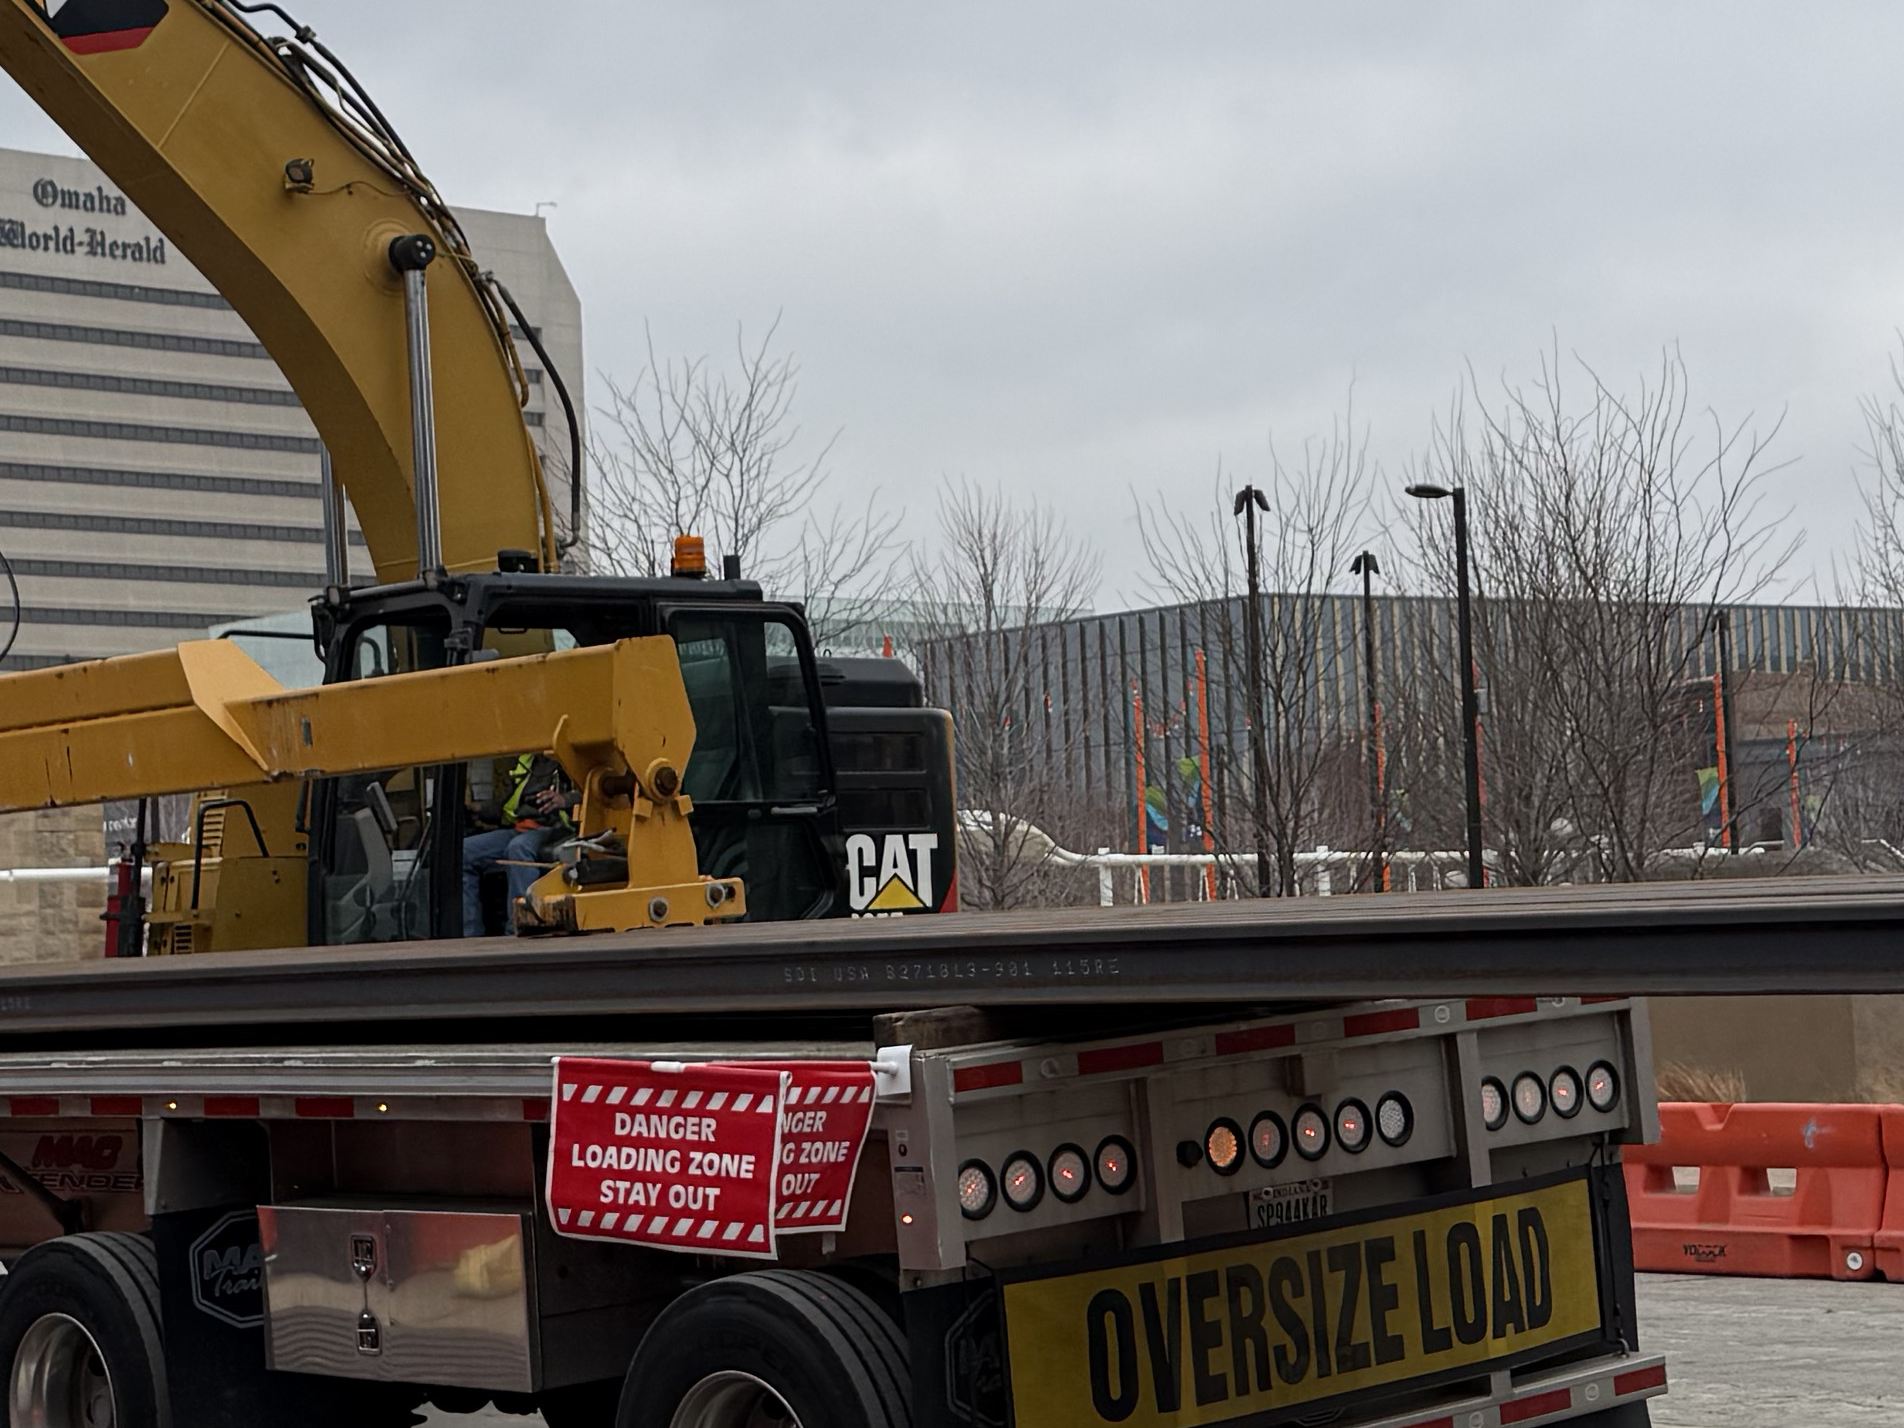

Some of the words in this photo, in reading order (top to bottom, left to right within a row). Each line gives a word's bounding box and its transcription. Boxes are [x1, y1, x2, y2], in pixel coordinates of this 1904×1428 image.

[32, 178, 127, 216] Omaha
[846, 834, 938, 910] CAT
[614, 1112, 717, 1142] DANGER
[571, 1143, 681, 1174] LOADING
[688, 1151, 756, 1179] ZONE
[799, 1141, 850, 1164] ZONE
[599, 1179, 662, 1207] STAY
[668, 1184, 721, 1211] OUT
[781, 1173, 820, 1196] OUT
[1086, 1236, 1405, 1423] OVERSIZE
[1412, 1206, 1553, 1355] LOAD
